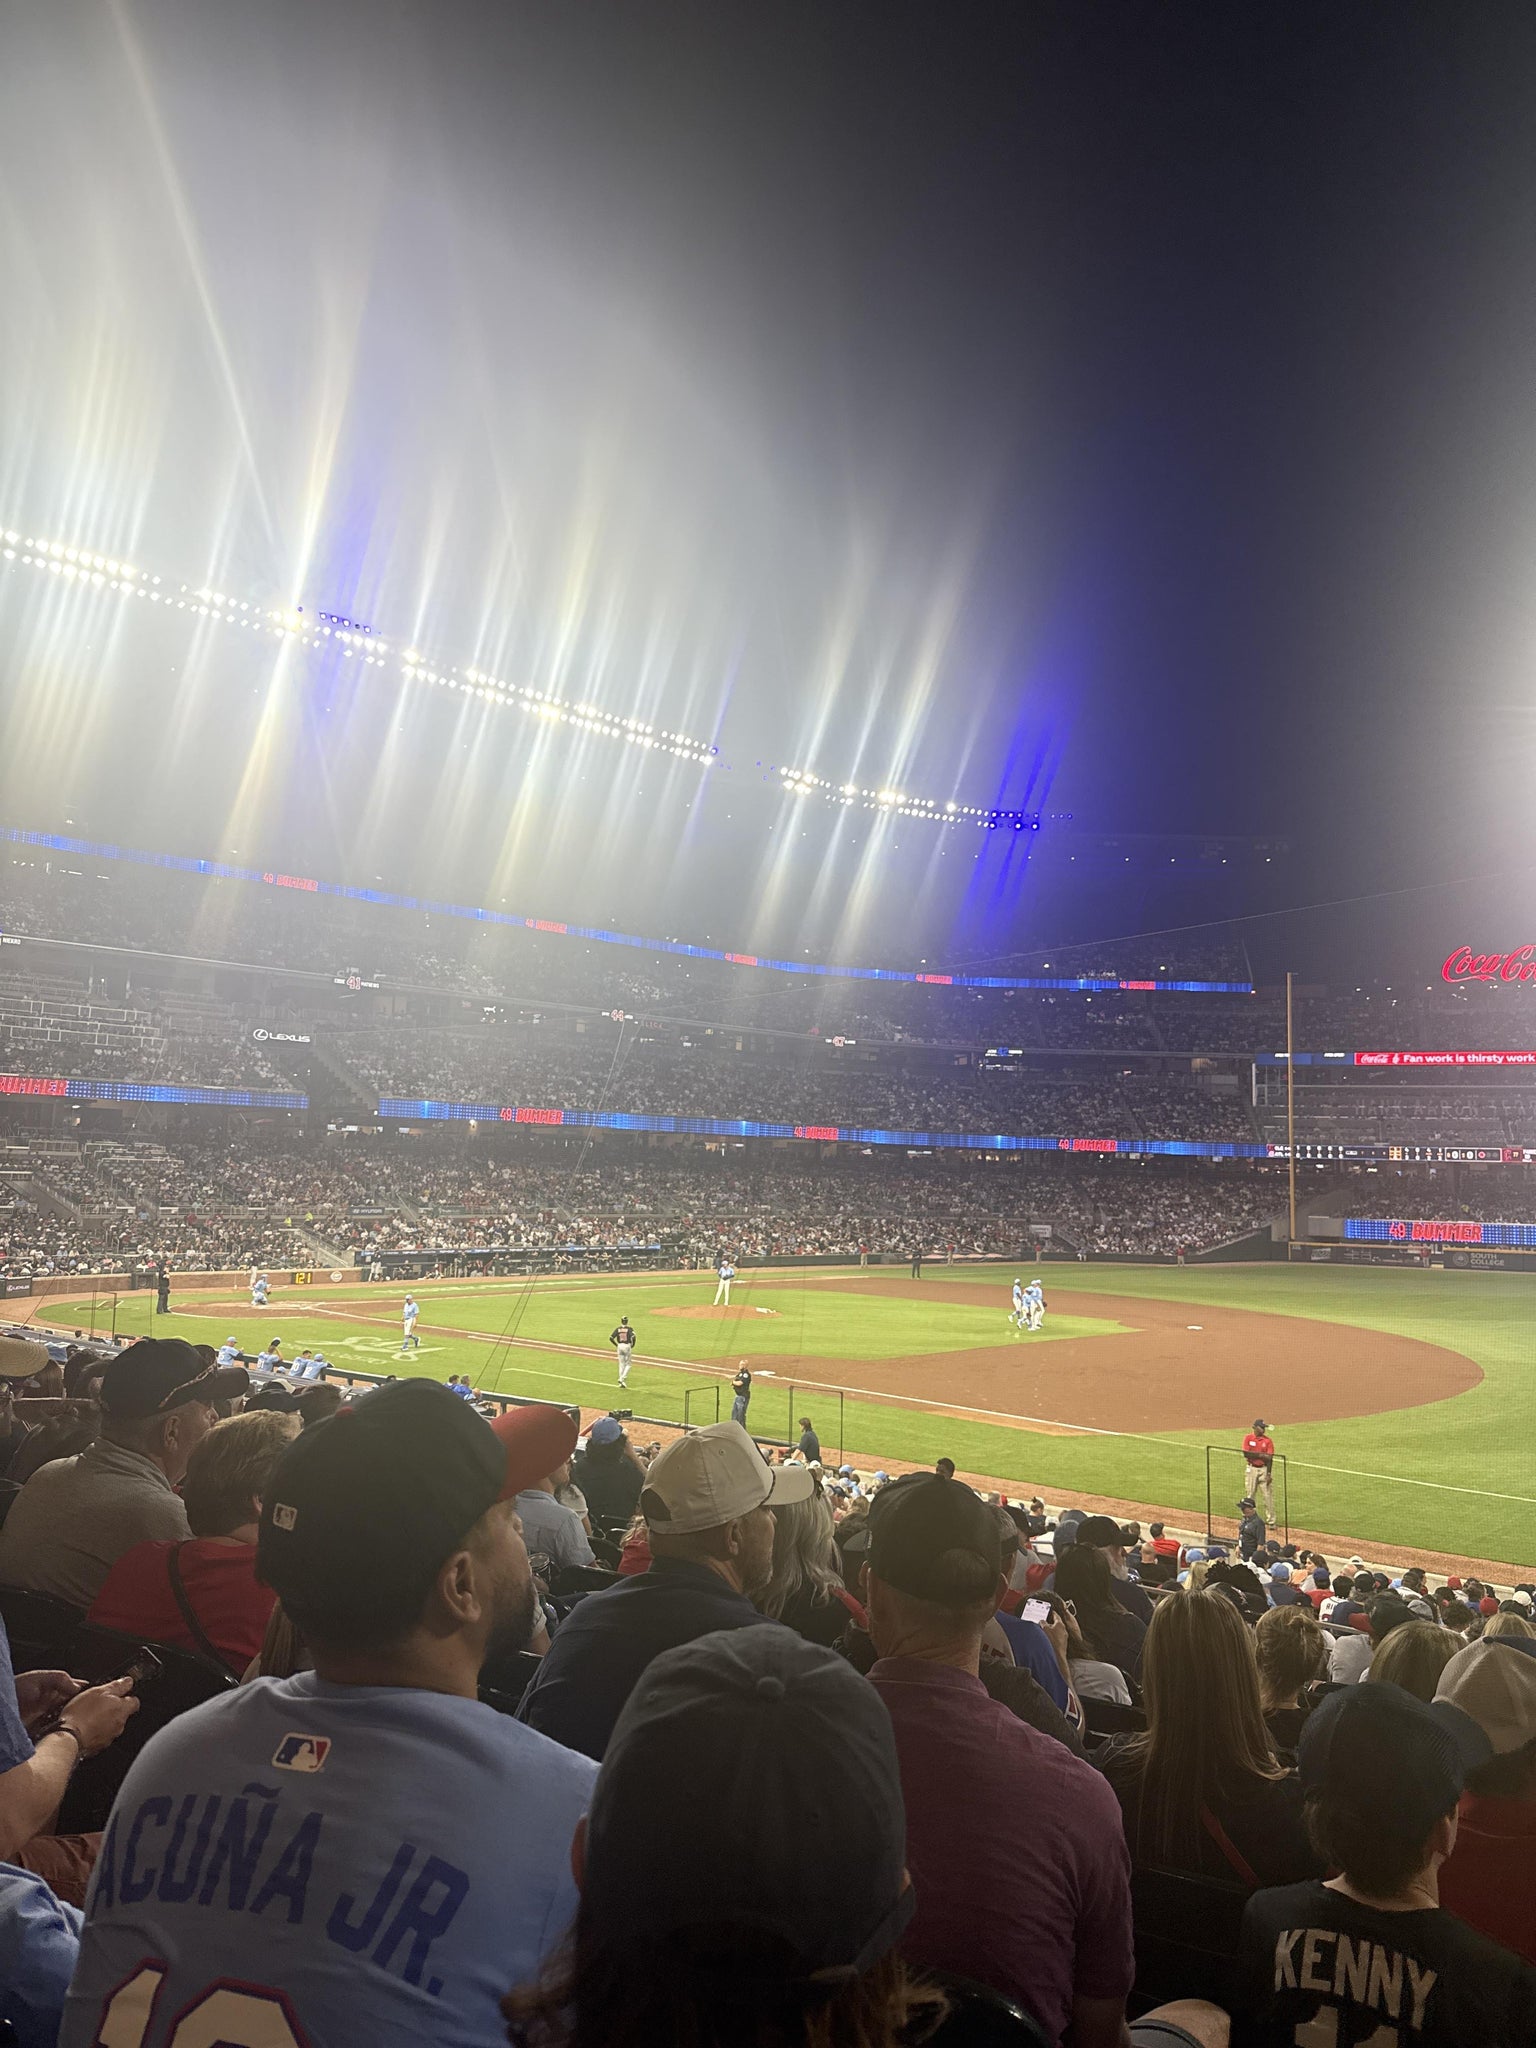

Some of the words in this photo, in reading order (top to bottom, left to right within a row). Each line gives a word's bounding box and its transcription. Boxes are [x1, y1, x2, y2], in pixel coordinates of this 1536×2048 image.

[1441, 944, 1536, 983] Coca-Co
[269, 1032, 311, 1043] LEXUS
[1403, 1055, 1423, 1063] Fan
[1425, 1054, 1453, 1063] work
[1455, 1054, 1465, 1063] is
[1467, 1054, 1504, 1065] thirsty
[1506, 1054, 1535, 1063] work
[515, 1107, 563, 1125] BUMMER
[1072, 1138, 1116, 1152] BUMMER
[1411, 1221, 1482, 1243] BUMMER
[92, 1782, 324, 1924] ACUÑA
[326, 1843, 470, 1997] JR.
[1275, 1929, 1438, 2032] KENNY
